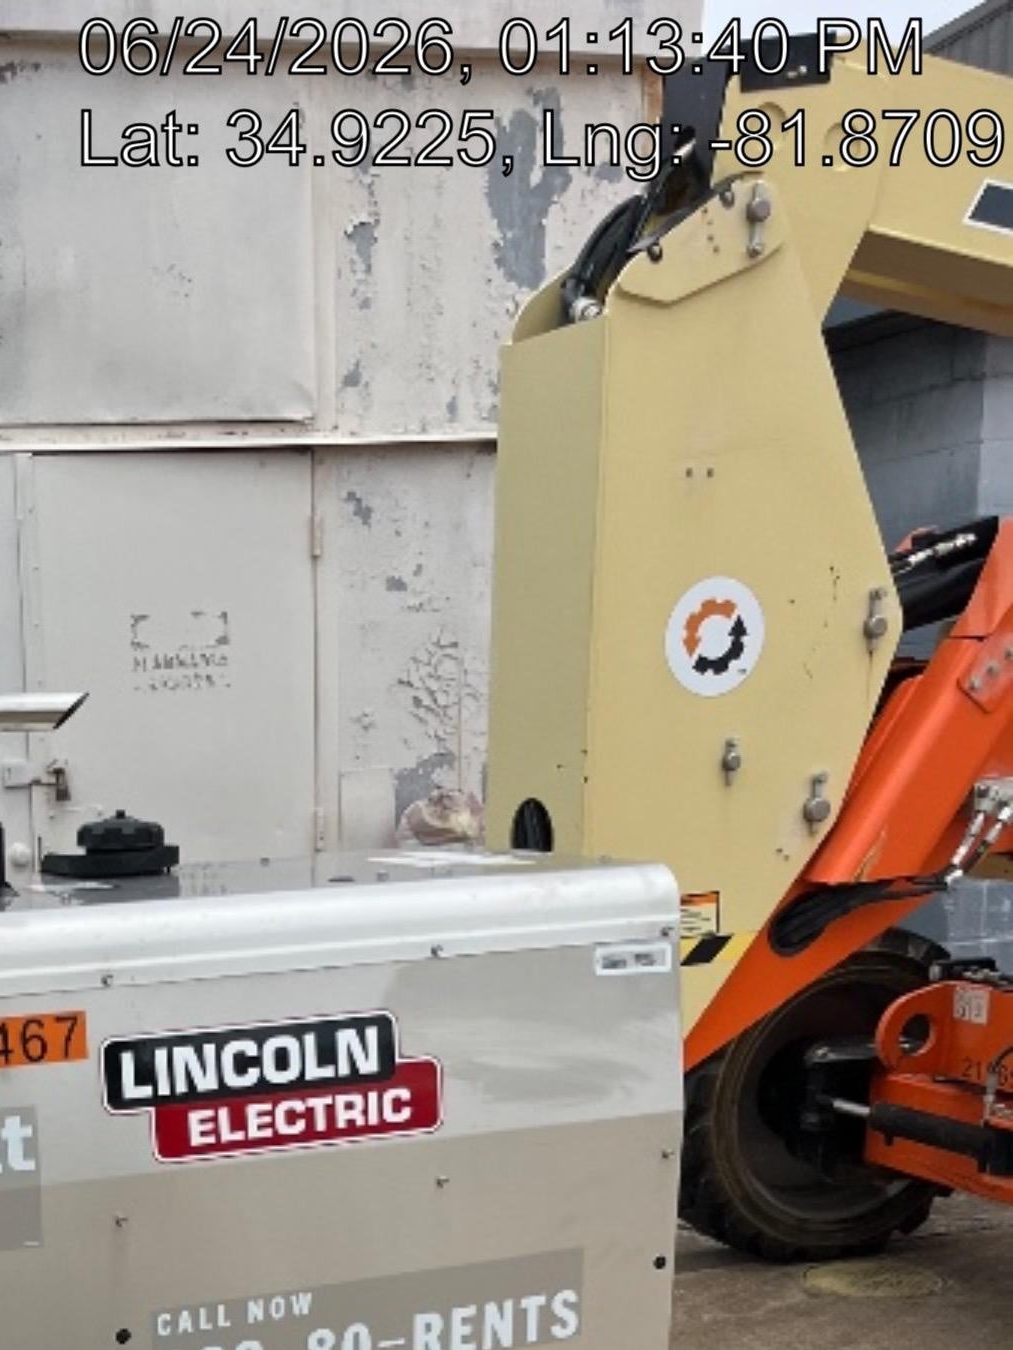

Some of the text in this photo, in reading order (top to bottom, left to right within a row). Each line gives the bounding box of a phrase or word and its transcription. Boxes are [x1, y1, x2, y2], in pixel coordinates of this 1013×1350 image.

[119, 1024, 381, 1099] LINCOLN
[189, 1087, 413, 1147] ELECTRIC
[156, 1292, 313, 1337] CALL NOW
